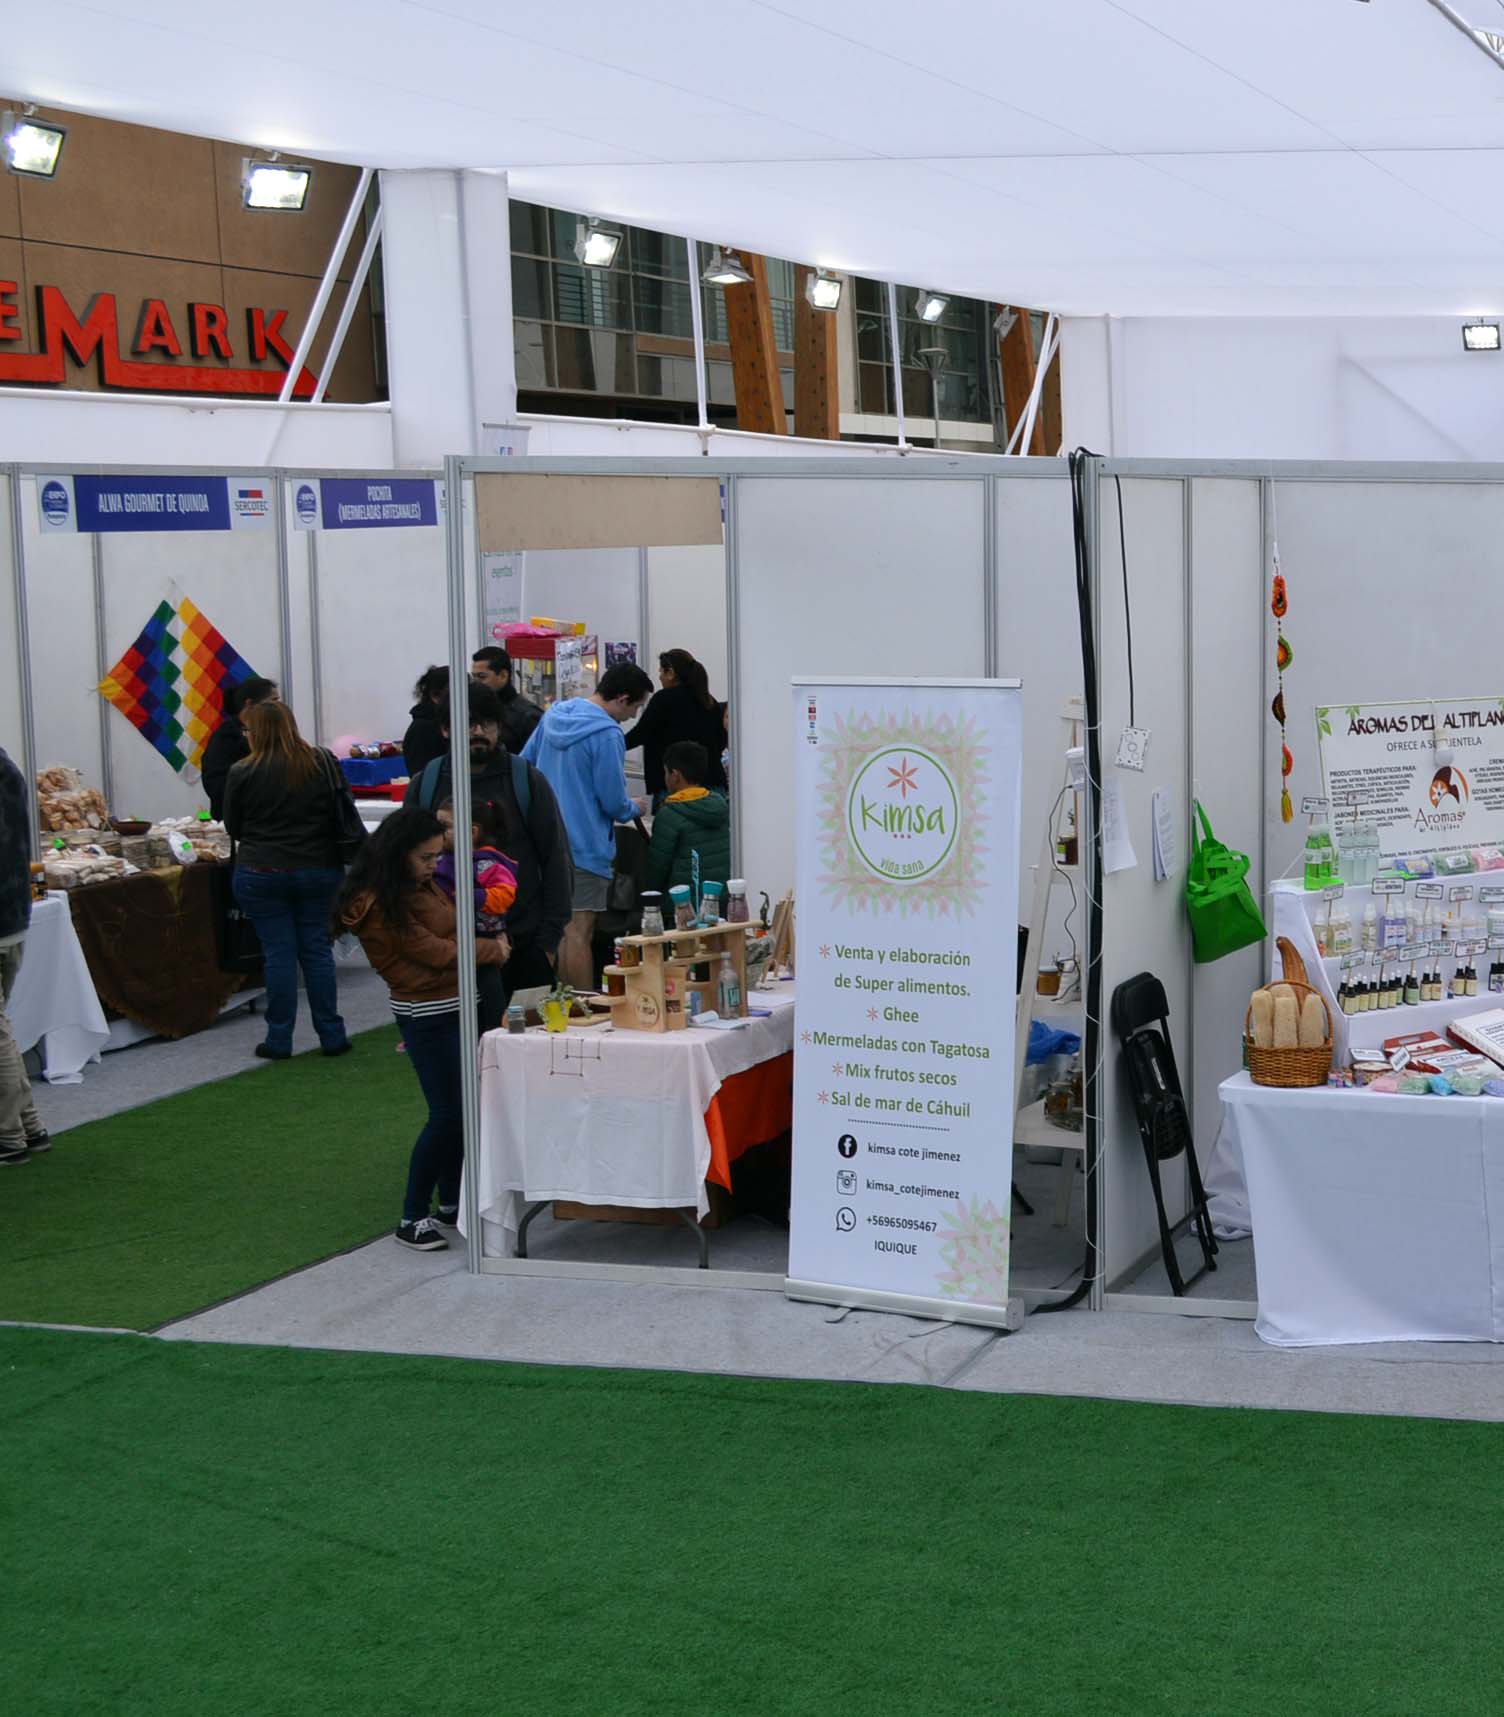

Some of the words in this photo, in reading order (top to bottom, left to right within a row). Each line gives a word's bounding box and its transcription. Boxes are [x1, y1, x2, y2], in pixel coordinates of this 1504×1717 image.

[98, 493, 124, 512] ALWA
[124, 493, 165, 513] GOURMET
[166, 494, 177, 512] DE
[179, 494, 210, 515] QUINOA
[234, 500, 269, 511] SERCOTEC
[1347, 715, 1408, 737] AROMAS
[1386, 740, 1418, 752] OFRECE
[1420, 740, 1426, 749] A
[861, 794, 945, 834] Kimsa
[1414, 808, 1463, 829] Aromas
[880, 858, 900, 874] vida
[902, 859, 925, 875] sana
[834, 944, 874, 961] Venta
[878, 949, 886, 964] y
[889, 948, 971, 966] elaboración
[834, 973, 851, 988] de
[855, 975, 894, 993] Super
[898, 978, 971, 997] alimentos.
[883, 1007, 919, 1023] Ghee
[813, 1031, 897, 1051] Mermeladas
[902, 1040, 926, 1054] con
[930, 1040, 990, 1059] Tagatosa
[845, 1063, 871, 1079] Mix
[874, 1064, 915, 1083] frutos
[919, 1071, 957, 1087] secos
[831, 1091, 851, 1106] Sal
[854, 1092, 871, 1108] de
[875, 1097, 902, 1112] mar
[906, 1096, 923, 1114] de
[927, 1099, 971, 1118] Cáhuil
[867, 1142, 896, 1156] kimsa
[898, 1147, 920, 1159] cote
[921, 1149, 961, 1162] jimenez
[866, 1179, 960, 1200] kimsa_cotejimenez
[866, 1215, 938, 1233] +56965095467
[874, 1240, 918, 1255] IQUIQUE
